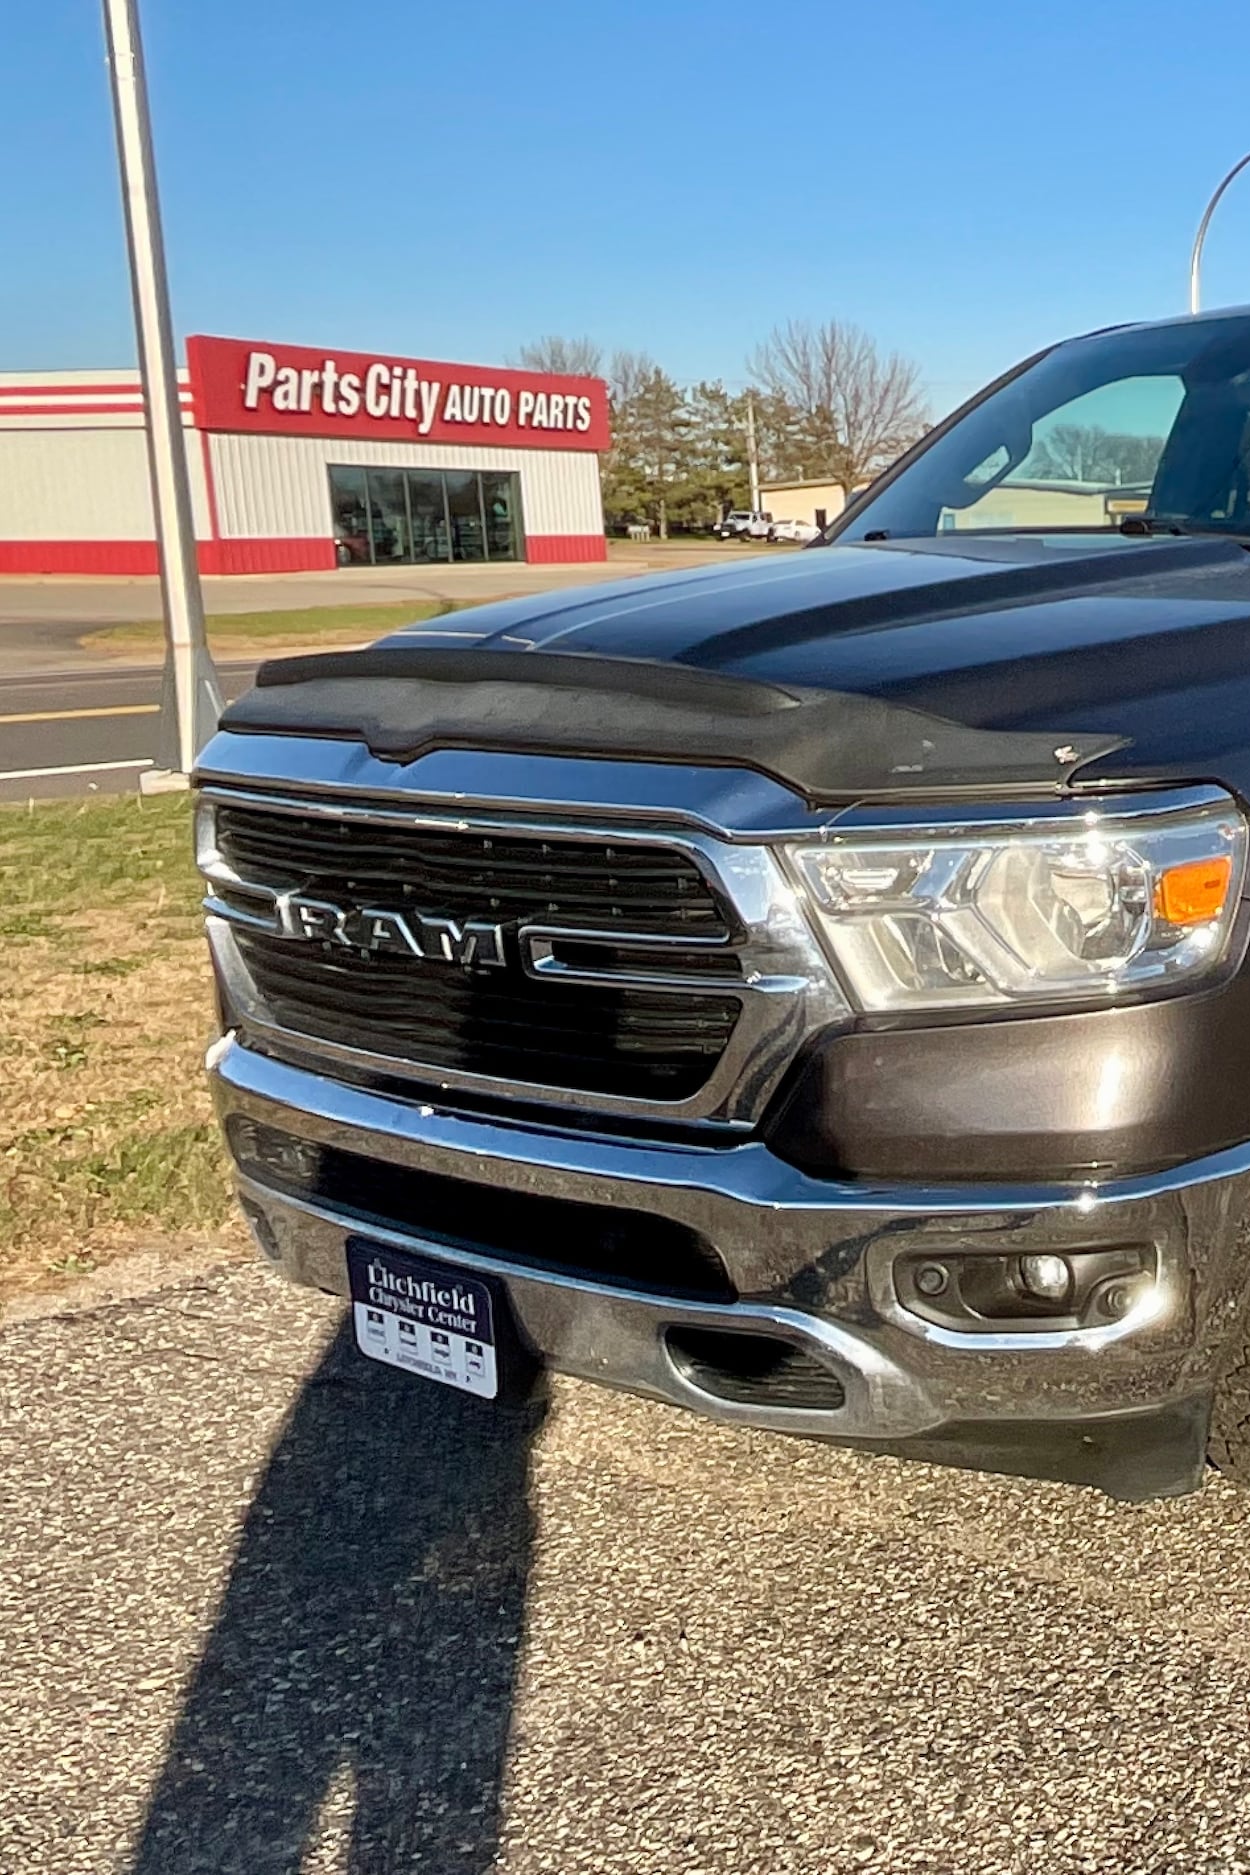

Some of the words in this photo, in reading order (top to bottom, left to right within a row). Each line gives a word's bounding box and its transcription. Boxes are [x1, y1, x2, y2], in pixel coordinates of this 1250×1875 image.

[443, 383, 511, 427] AUTO
[517, 390, 592, 432] PARTS
[275, 894, 507, 968] RAM
[368, 1264, 475, 1316] Litchfield
[369, 1287, 425, 1319] Chrysler
[427, 1306, 477, 1334] Center
